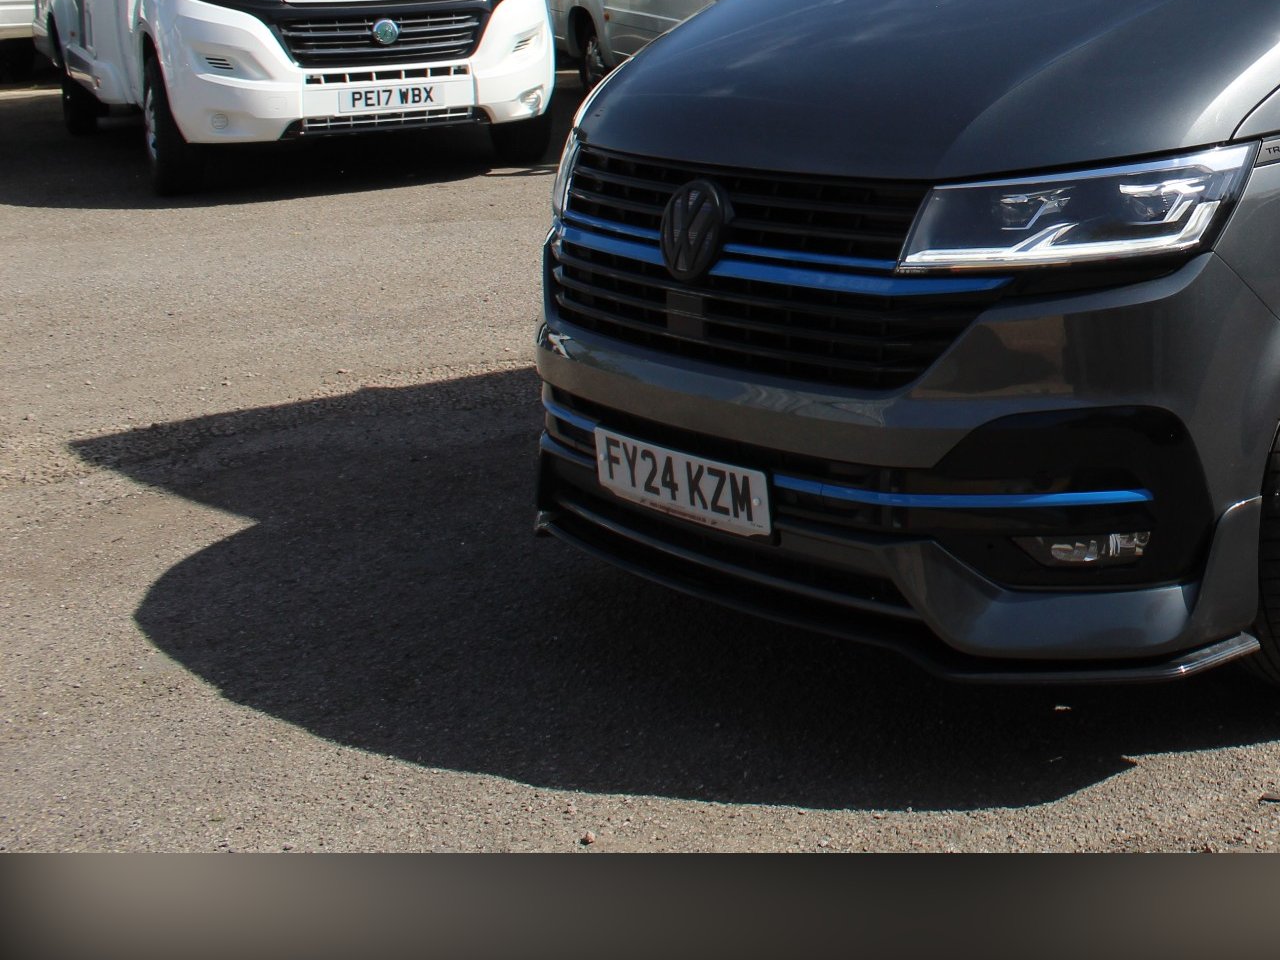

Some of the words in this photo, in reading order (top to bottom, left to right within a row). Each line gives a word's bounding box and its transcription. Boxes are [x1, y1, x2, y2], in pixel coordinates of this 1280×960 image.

[351, 89, 393, 108] PE17
[399, 86, 434, 105] WBX
[605, 435, 680, 501] FY24
[685, 460, 754, 522] KZM
